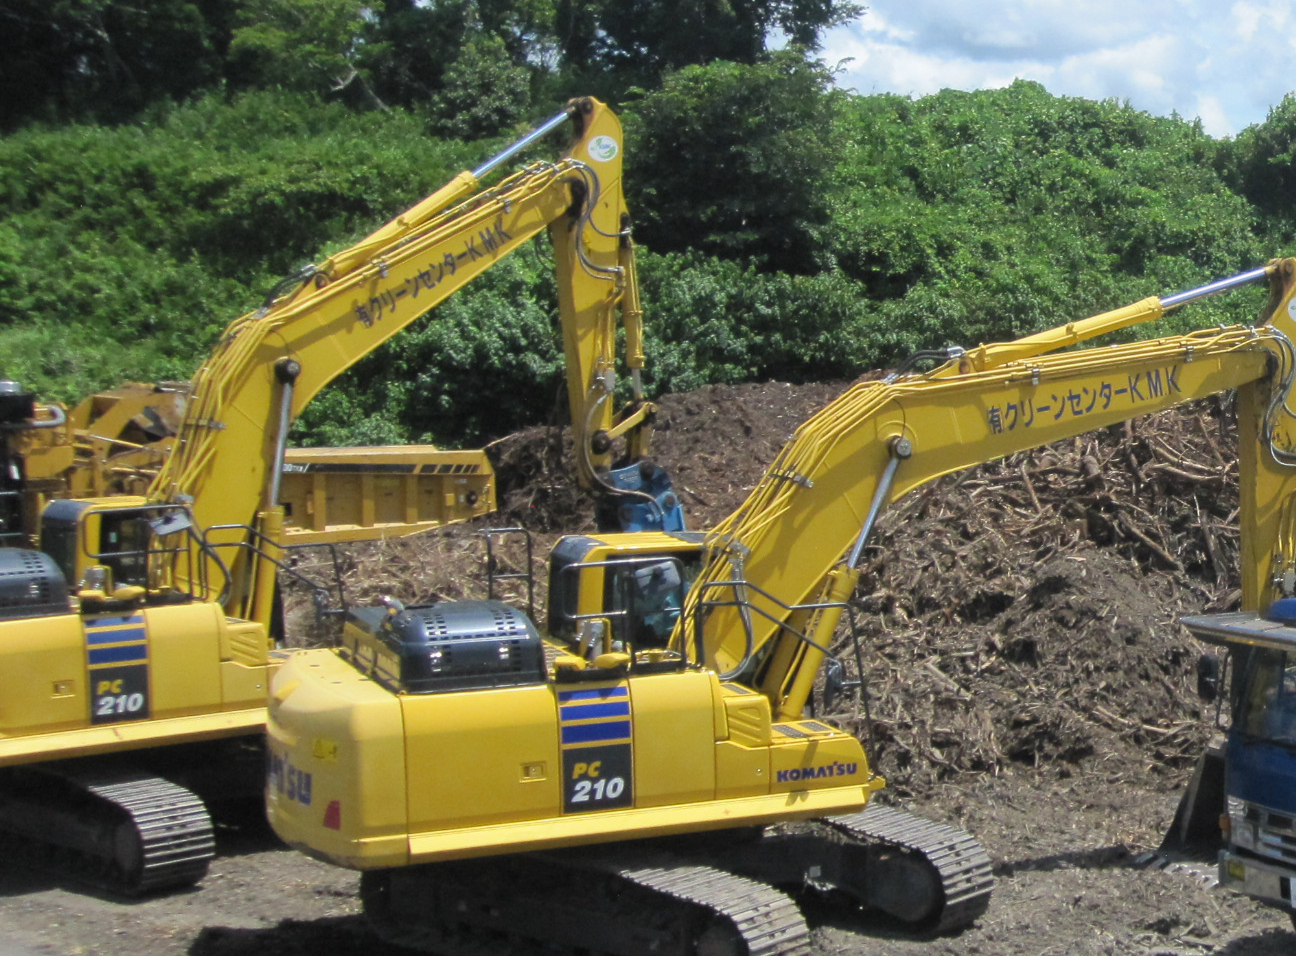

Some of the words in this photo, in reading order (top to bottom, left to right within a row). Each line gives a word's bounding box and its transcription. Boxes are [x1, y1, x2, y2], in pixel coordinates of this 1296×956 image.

[96, 678, 124, 696] PC
[96, 692, 144, 716] 210
[572, 760, 602, 780] PC
[777, 760, 857, 783] KOMATSU
[571, 776, 625, 803] 210
